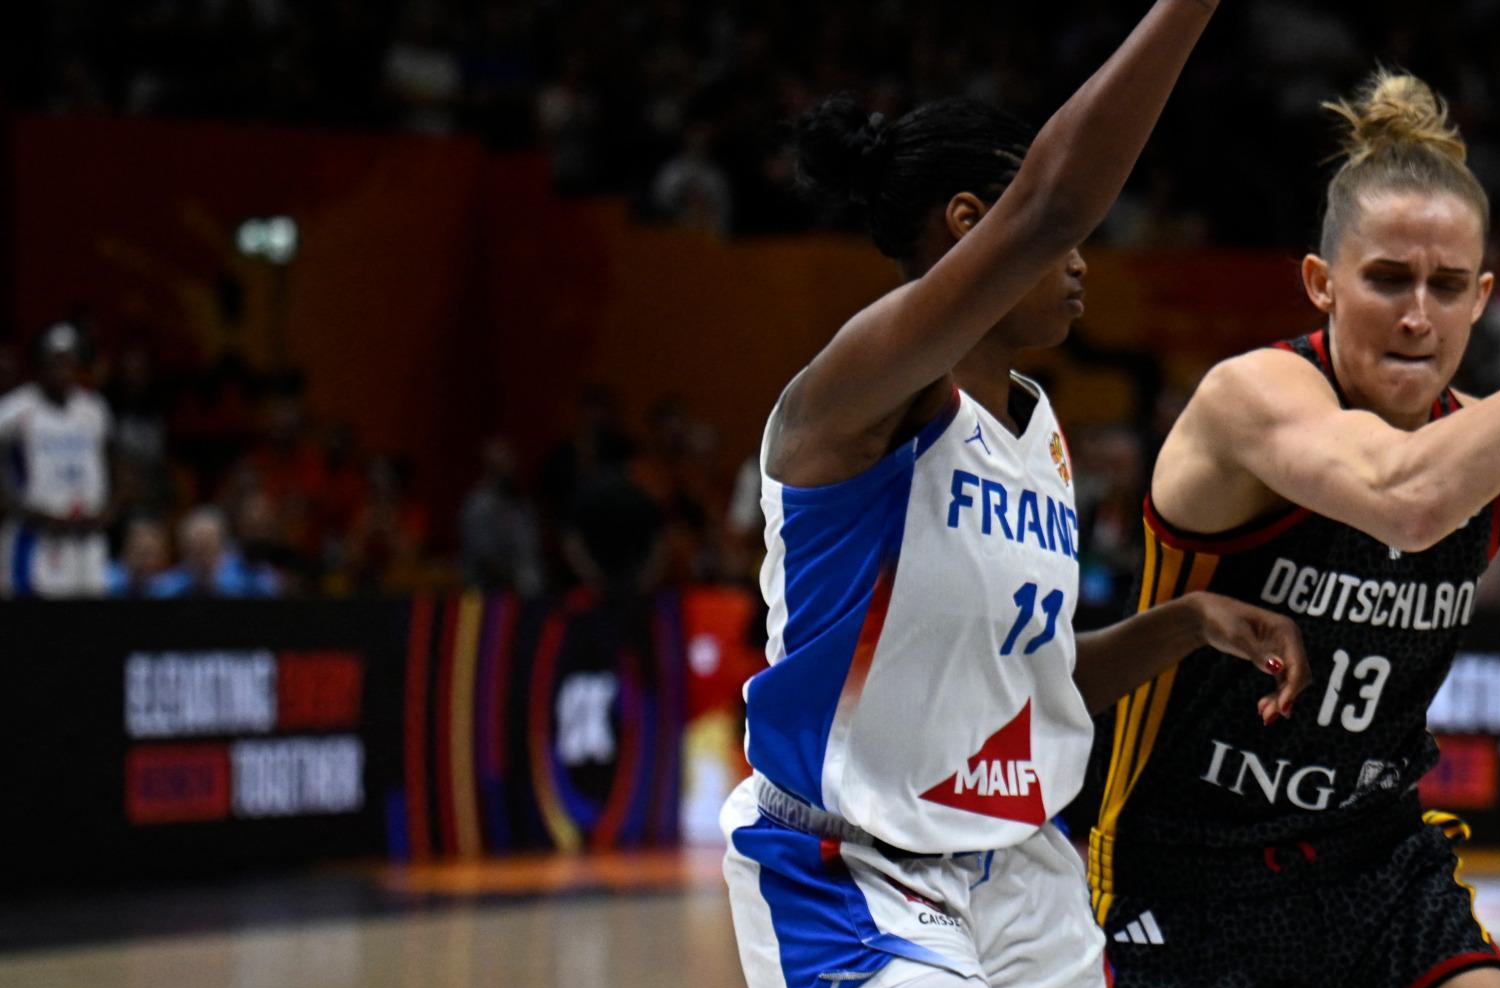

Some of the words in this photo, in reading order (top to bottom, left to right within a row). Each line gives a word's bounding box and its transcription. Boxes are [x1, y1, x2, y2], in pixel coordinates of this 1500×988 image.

[947, 469, 1079, 562] FRANC
[999, 582, 1064, 656] 11
[1260, 557, 1481, 630] DEUTSCHLAN
[1317, 649, 1391, 732] 13
[954, 760, 1037, 797] MAIF
[1200, 739, 1336, 811] ING
